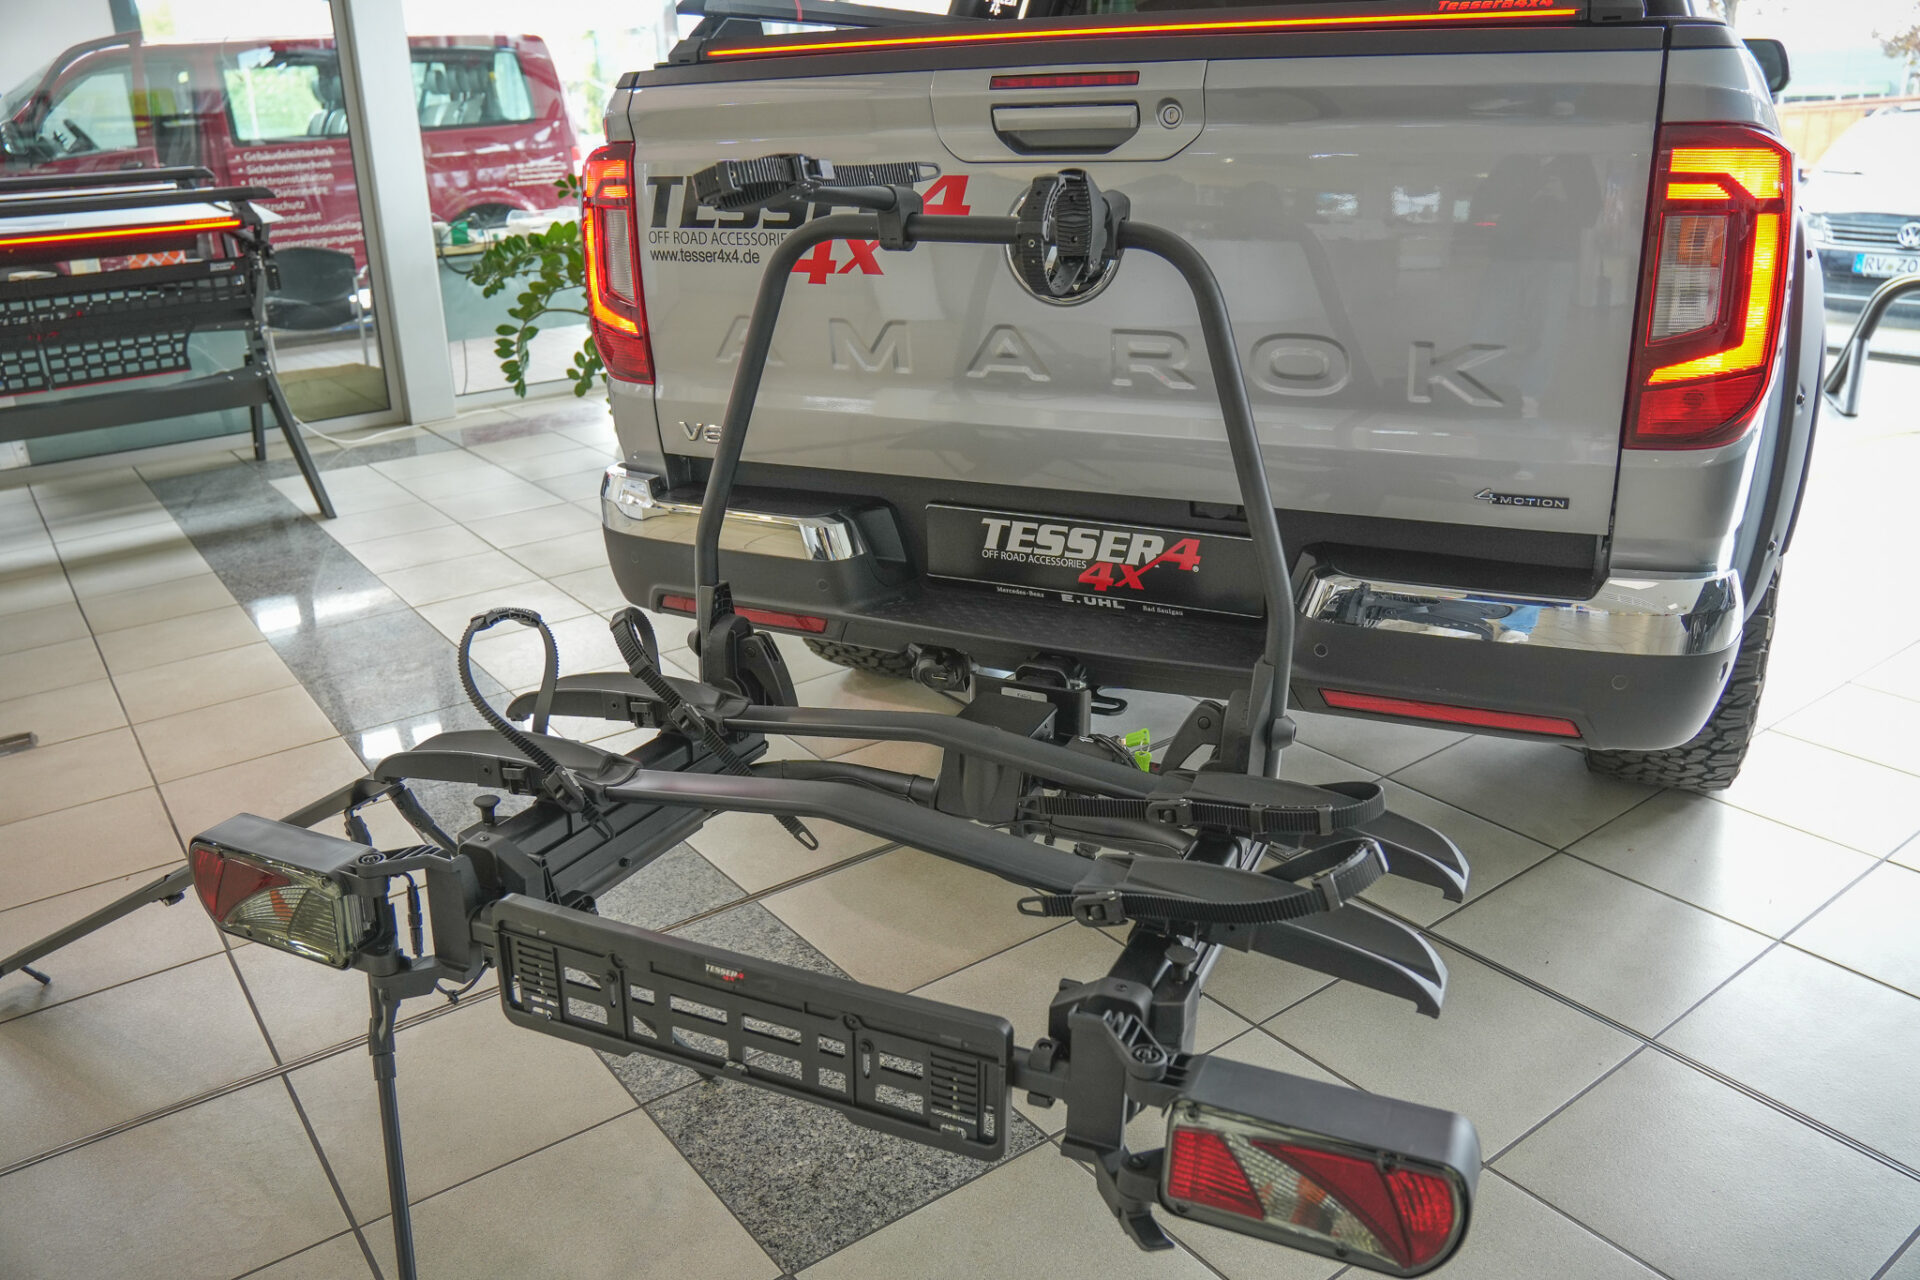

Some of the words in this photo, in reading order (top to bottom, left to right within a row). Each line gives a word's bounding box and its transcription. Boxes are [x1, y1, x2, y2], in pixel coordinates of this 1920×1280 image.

[648, 230, 670, 244] OFF
[673, 231, 707, 246] ROAD
[650, 248, 760, 264] www.tesser4x4.de
[678, 421, 722, 444] V6
[1474, 487, 1565, 508] 4MOTION
[982, 549, 999, 560] OFF
[1000, 551, 1027, 563] ROAD
[1028, 554, 1087, 569] ACCESSORIES
[996, 585, 1045, 599] Mercedes-Benz
[1142, 604, 1156, 614] Bad
